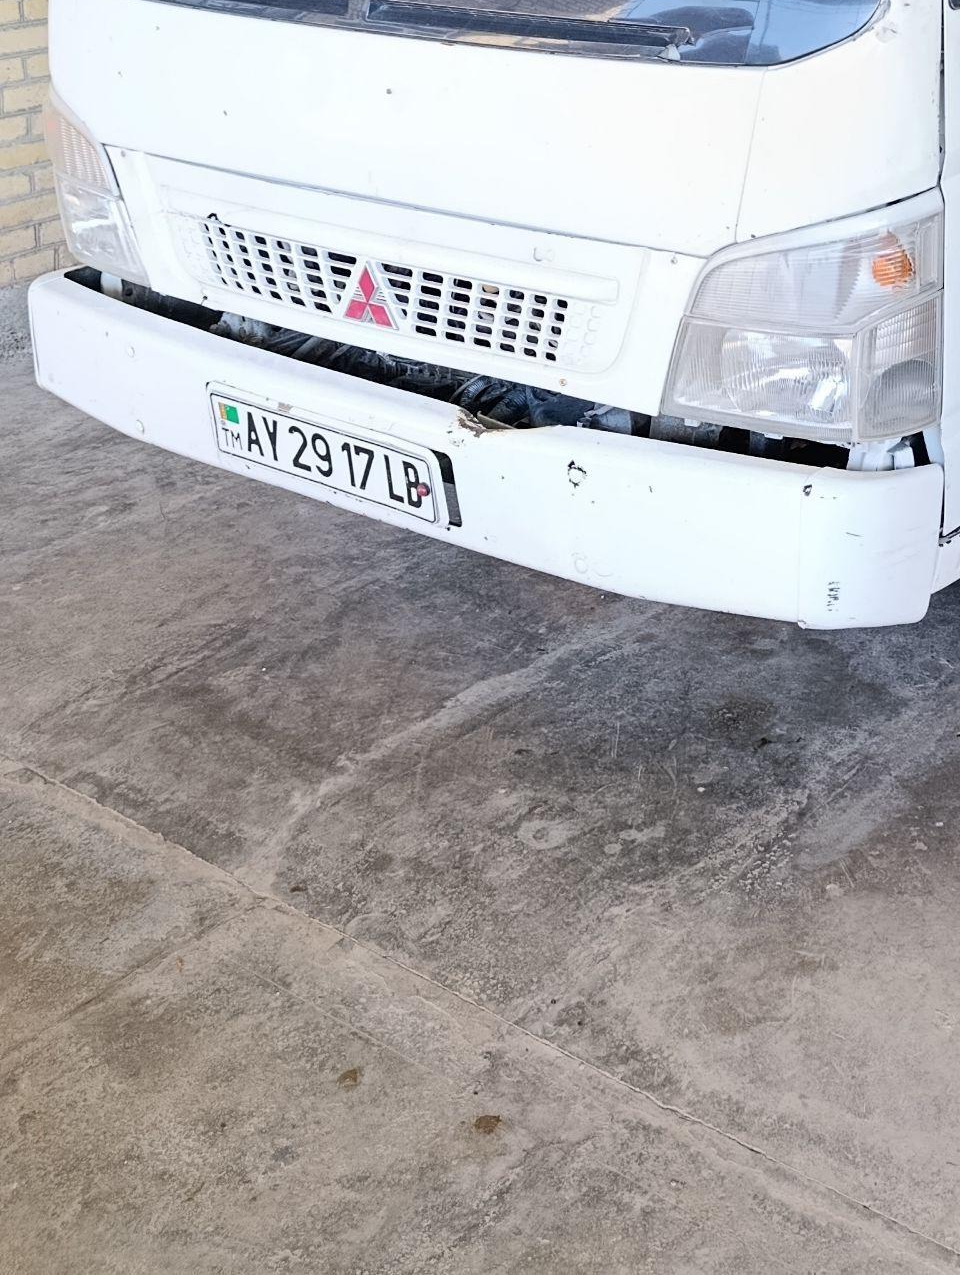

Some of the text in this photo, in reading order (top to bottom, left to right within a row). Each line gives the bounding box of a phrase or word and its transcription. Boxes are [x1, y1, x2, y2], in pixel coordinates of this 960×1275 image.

[221, 427, 243, 450] TM
[247, 411, 279, 461] AY
[384, 454, 423, 508] LB
